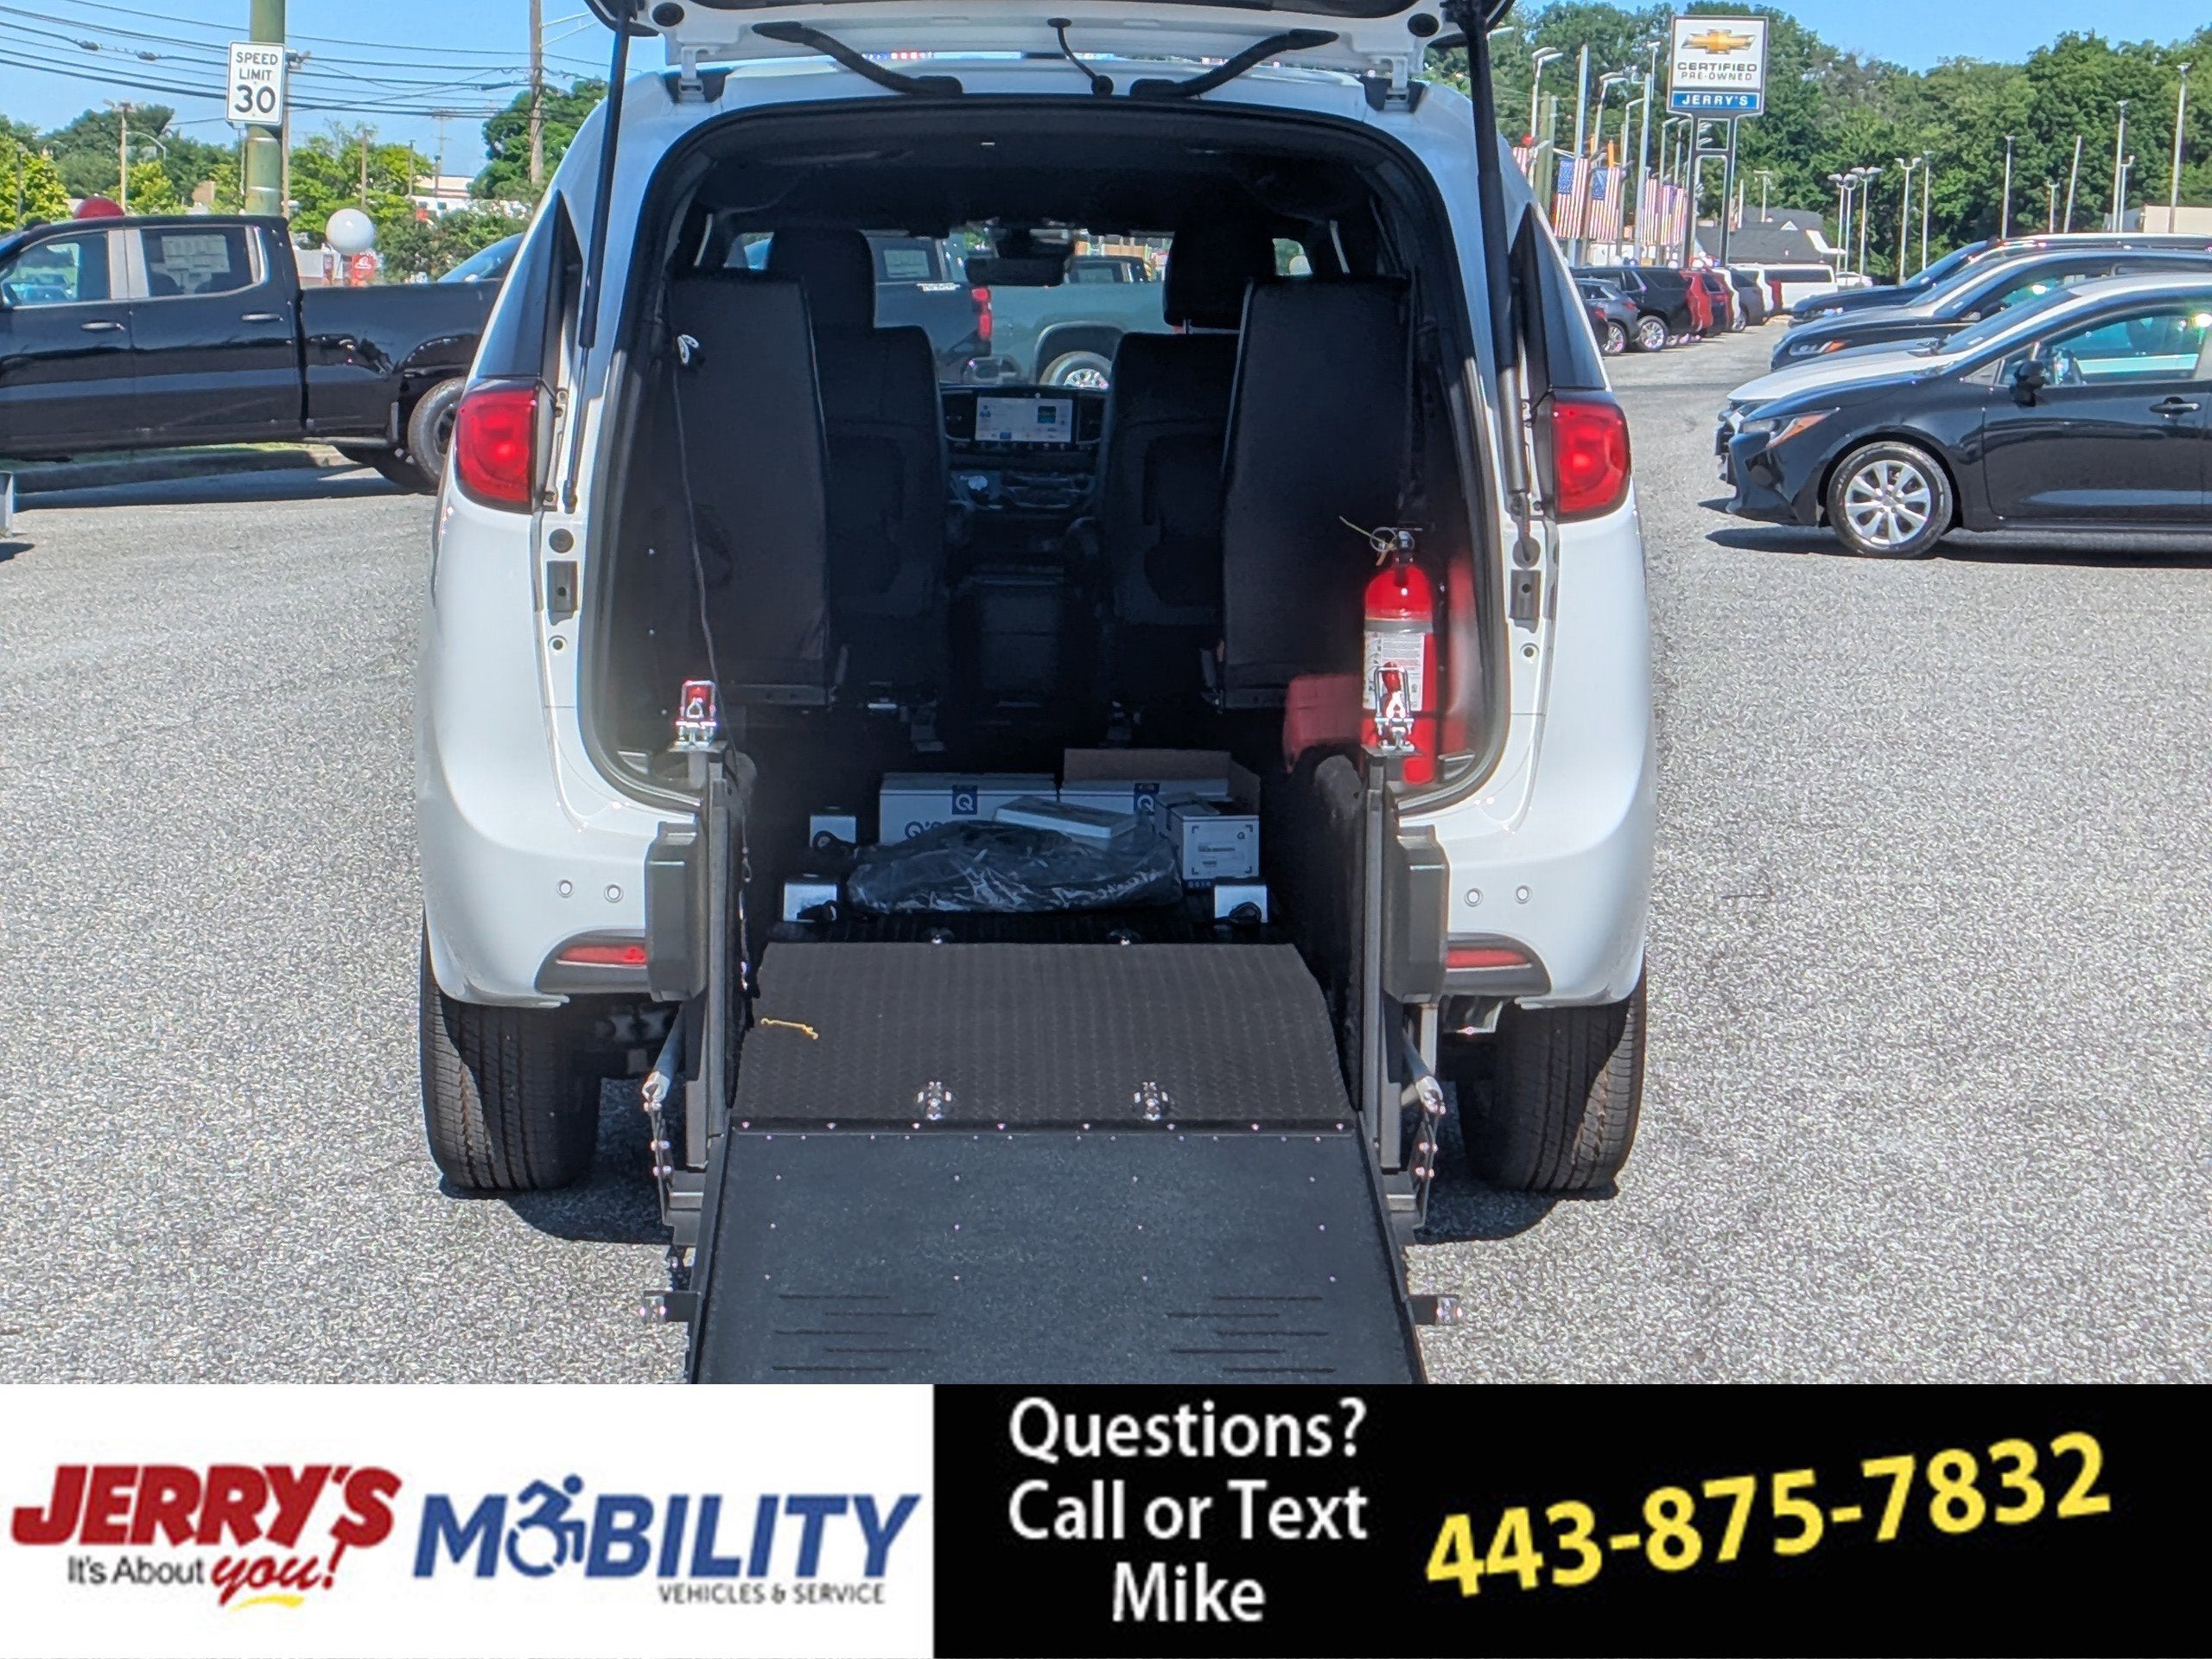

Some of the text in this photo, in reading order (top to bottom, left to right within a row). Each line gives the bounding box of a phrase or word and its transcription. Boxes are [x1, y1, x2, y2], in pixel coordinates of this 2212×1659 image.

[236, 52, 278, 66] SPEED
[1677, 61, 1758, 72] CERTIFIED
[239, 68, 273, 80] LIMIT
[1681, 71, 1752, 81] PRE-OWNED
[234, 84, 276, 114] 30
[1681, 94, 1748, 106] JERRY'S
[955, 793, 974, 811] Q
